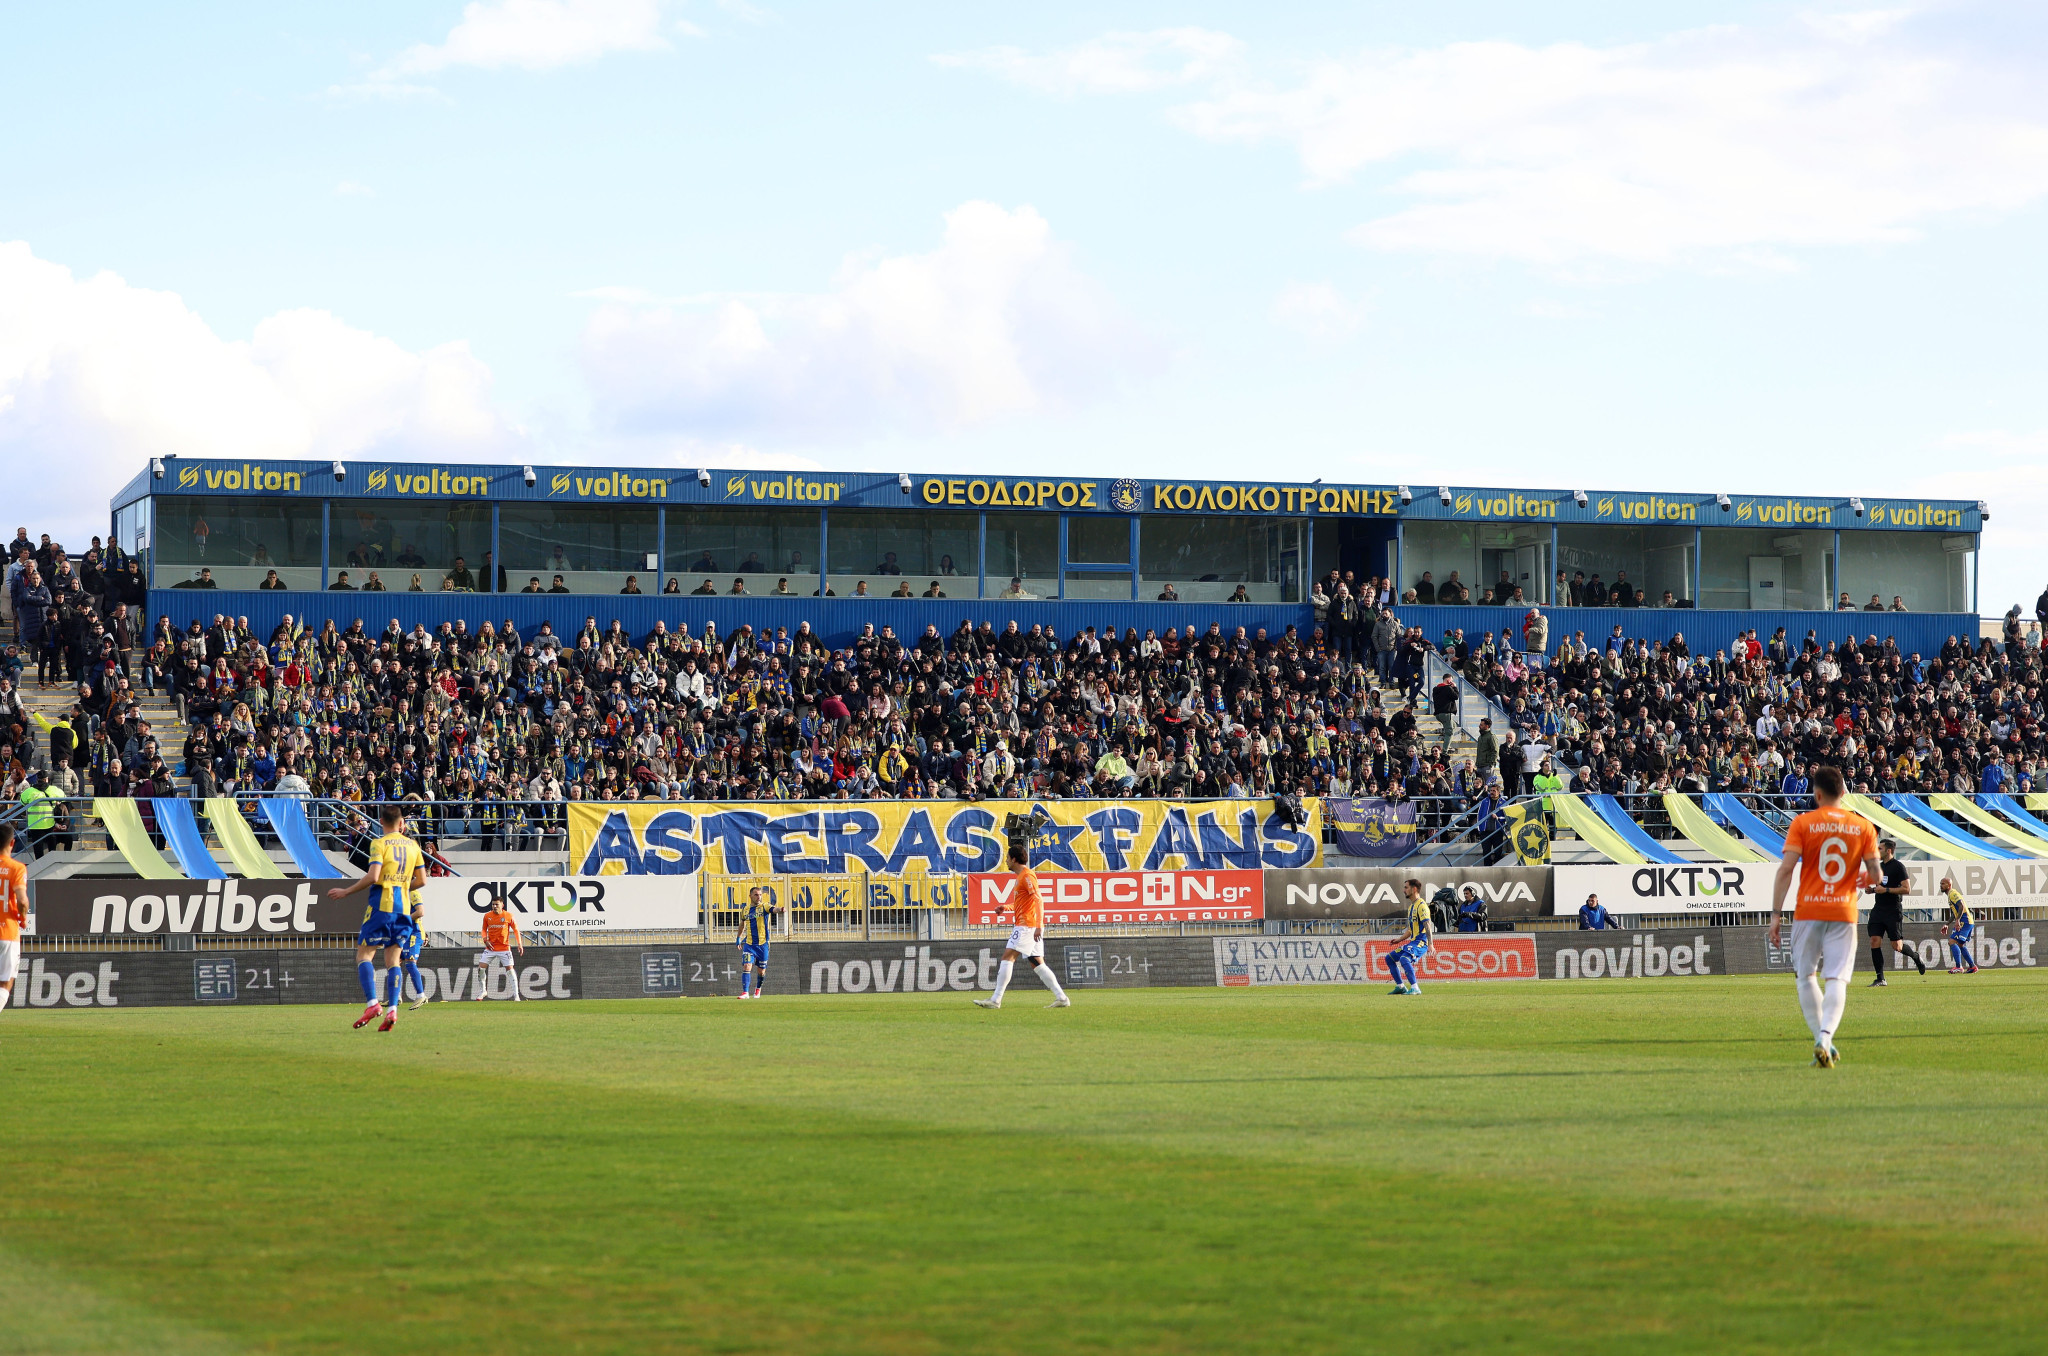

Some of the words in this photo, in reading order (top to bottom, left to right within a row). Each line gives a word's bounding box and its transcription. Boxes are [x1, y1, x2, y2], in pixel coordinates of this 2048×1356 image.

[205, 464, 300, 490] volton
[394, 469, 487, 495] volton
[576, 472, 667, 497] volton
[751, 475, 840, 501] volton
[923, 479, 1097, 508] ΘΕΟΔΩΡΟΣ
[1154, 485, 1398, 514] ΚΟΛΟΚΟΤΡΩΝΗΣ
[1478, 493, 1556, 517] volton
[1619, 496, 1696, 520] volton
[1757, 500, 1831, 523] volton
[1890, 503, 1961, 526] volton
[1809, 822, 1860, 836] KARACHALIOS
[577, 808, 1003, 880] ASTERAS
[1083, 806, 1317, 869] FANS
[393, 846, 407, 875] 41
[1818, 837, 1848, 884] 6
[1906, 864, 2048, 896] ΣΙΑΒΛΗ
[699, 885, 812, 910] LLOW
[1286, 883, 1400, 905] NOVA
[1426, 881, 1536, 903] NOVA
[1712, 901, 1746, 909] ΕΤΑΙΡΕΙΩΝ
[90, 879, 318, 933] novibet
[981, 915, 1069, 924] SPTS
[1080, 913, 1178, 922] MEDICAL
[1188, 911, 1253, 920] EQUIP
[533, 919, 564, 927] ΟΜΙΛΟΣ
[566, 918, 606, 927] ΕΤΑΙΡΕΙΩΝ
[1252, 940, 1360, 960] ΚΥΠΕΛΛΟ
[1370, 945, 1523, 975] btsson
[1555, 933, 1711, 979] novibet
[689, 961, 737, 982] 21+
[810, 946, 997, 993] novibet
[1109, 955, 1153, 975] 21+
[1253, 963, 1362, 983] ΕΛΛΑΔΑΣ
[13, 958, 119, 1006] ibet
[245, 968, 295, 989] 21+
